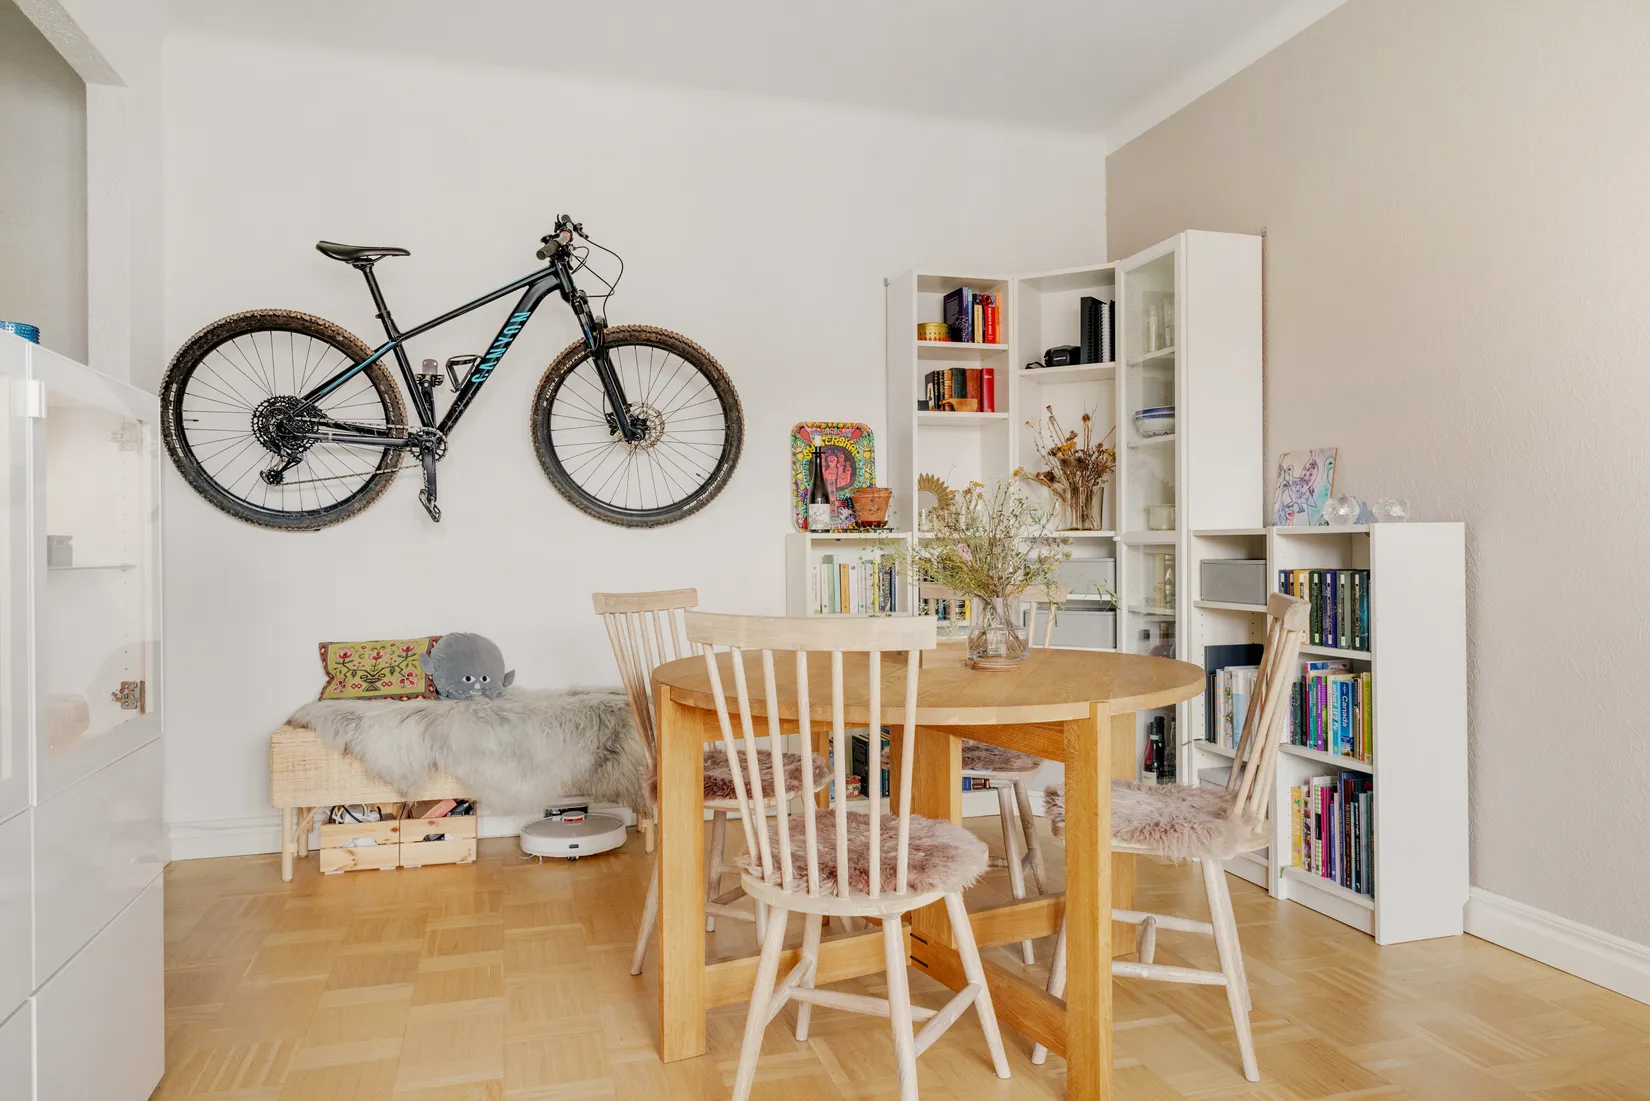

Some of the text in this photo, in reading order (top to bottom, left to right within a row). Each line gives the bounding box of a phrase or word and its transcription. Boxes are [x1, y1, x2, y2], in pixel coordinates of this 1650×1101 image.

[471, 311, 532, 383] CANYON
[560, 351, 588, 374] OUGH
[168, 383, 185, 457] SCHWALBE
[803, 435, 862, 460] SYTERSKAP
[682, 462, 728, 511] SCHWALBE
[1341, 695, 1349, 728] Canada
